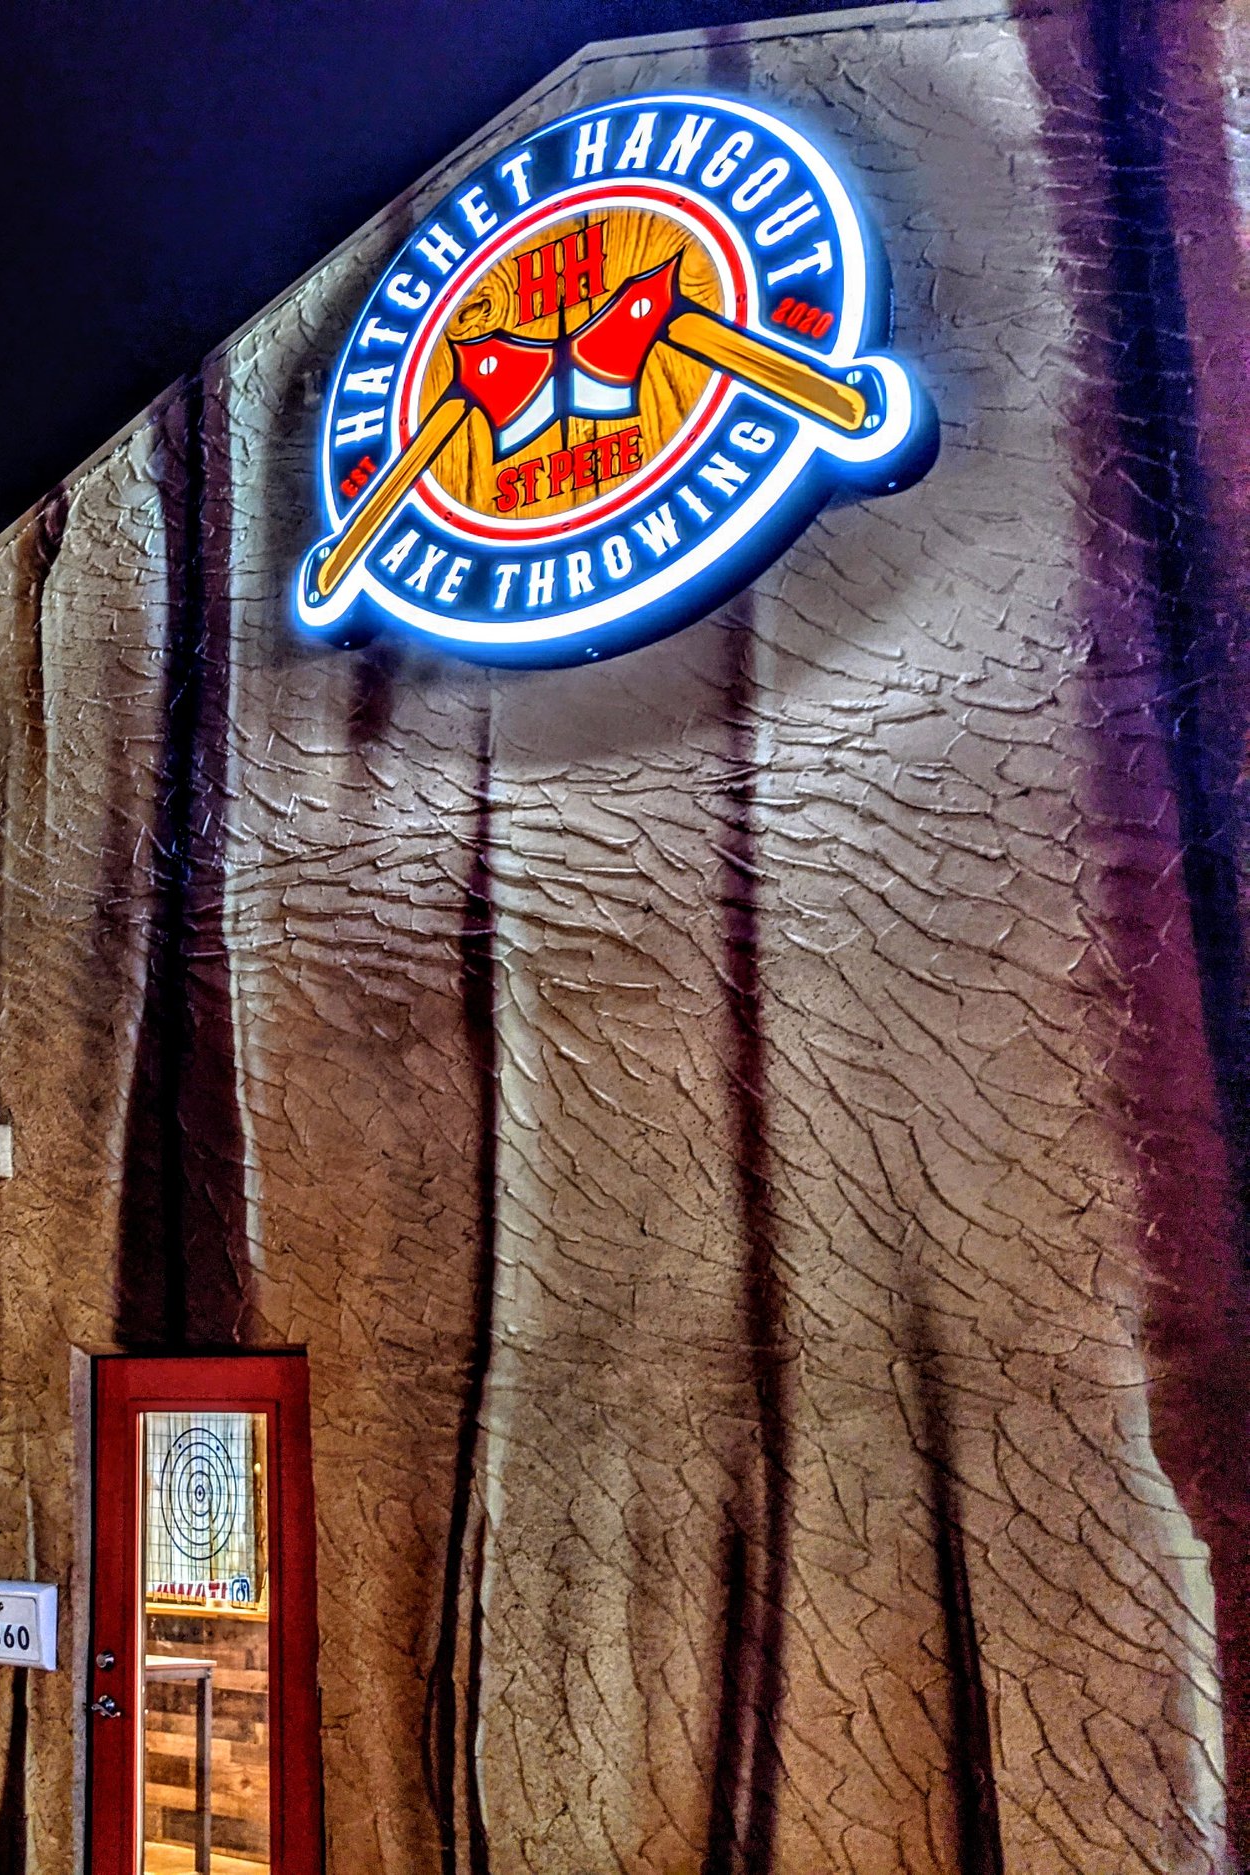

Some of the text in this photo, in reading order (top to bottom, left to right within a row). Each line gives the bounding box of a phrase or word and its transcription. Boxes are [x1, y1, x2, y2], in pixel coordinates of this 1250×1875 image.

[333, 109, 833, 447] HATCHET HANGOUT
[512, 217, 610, 327] HH
[771, 297, 834, 339] 2020
[340, 455, 378, 498] EST
[377, 421, 778, 610] AXE THROWING
[492, 424, 644, 513] ST PETE
